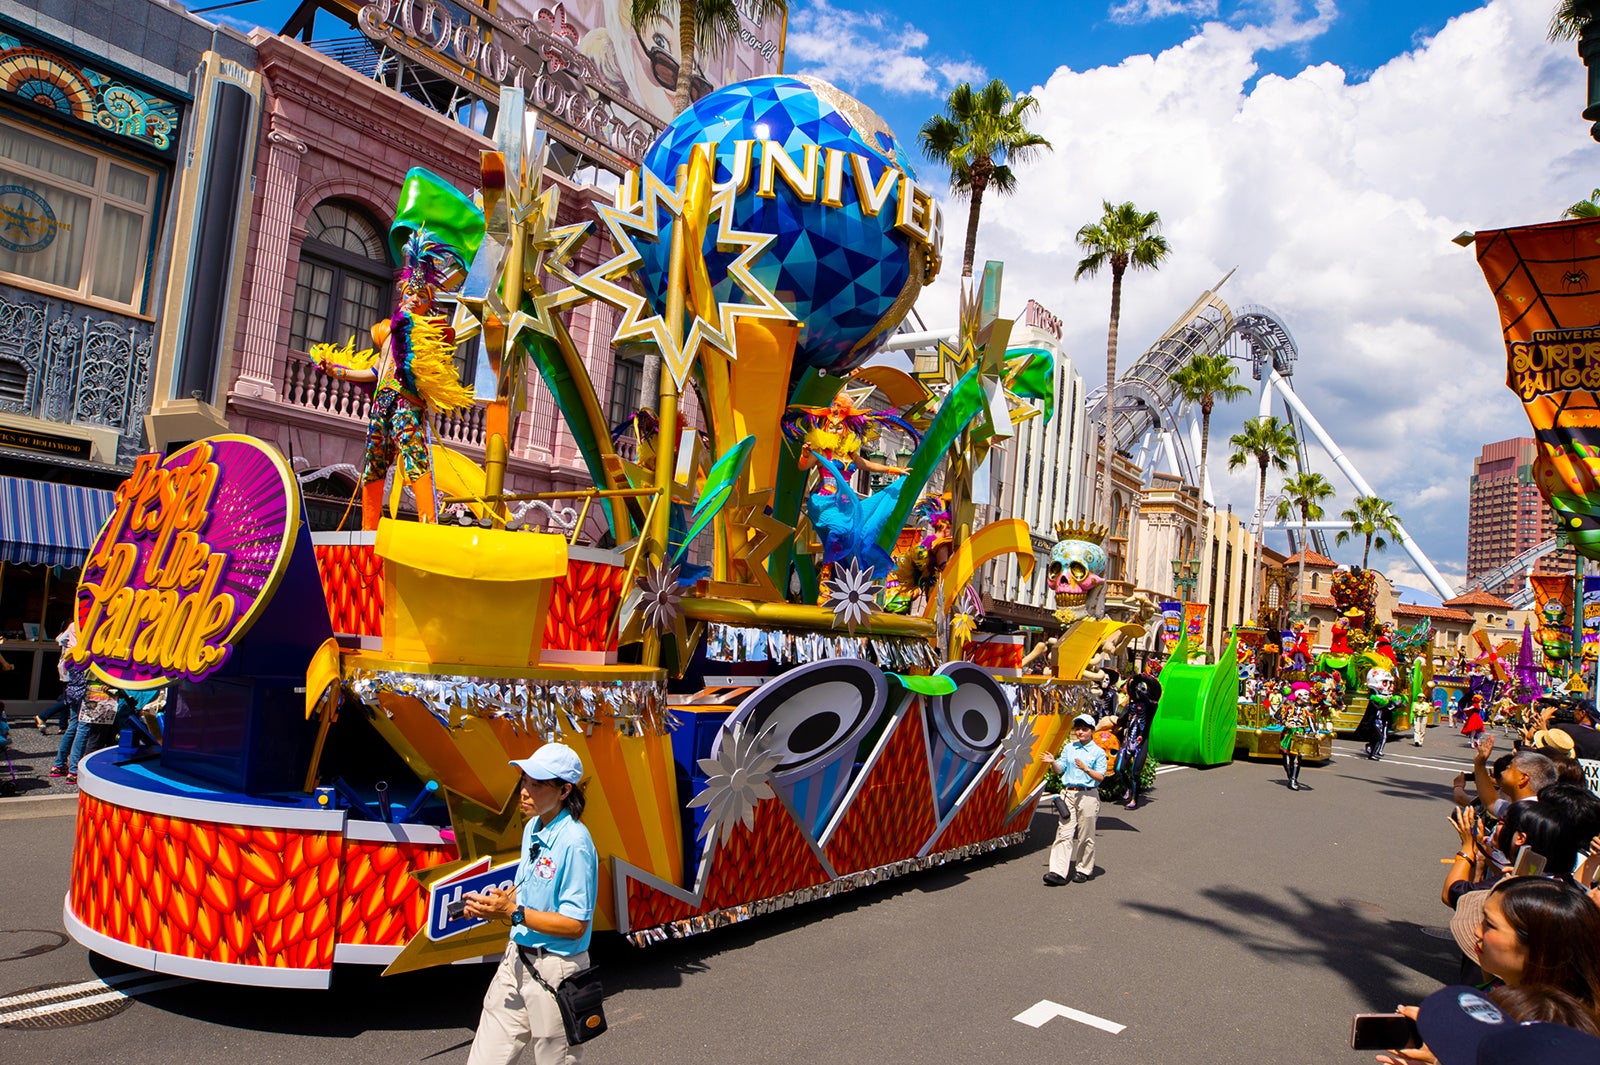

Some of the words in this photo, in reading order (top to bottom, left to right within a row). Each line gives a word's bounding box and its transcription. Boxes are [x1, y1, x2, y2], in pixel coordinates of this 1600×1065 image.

[741, 29, 777, 63] world
[1513, 342, 1600, 373] SURPR
[19, 436, 30, 444] OF
[32, 439, 81, 453] HOLLYWOOD
[88, 442, 219, 587] Festa
[157, 531, 211, 590] De
[64, 543, 237, 675] Parade
[1582, 766, 1599, 778] AX
